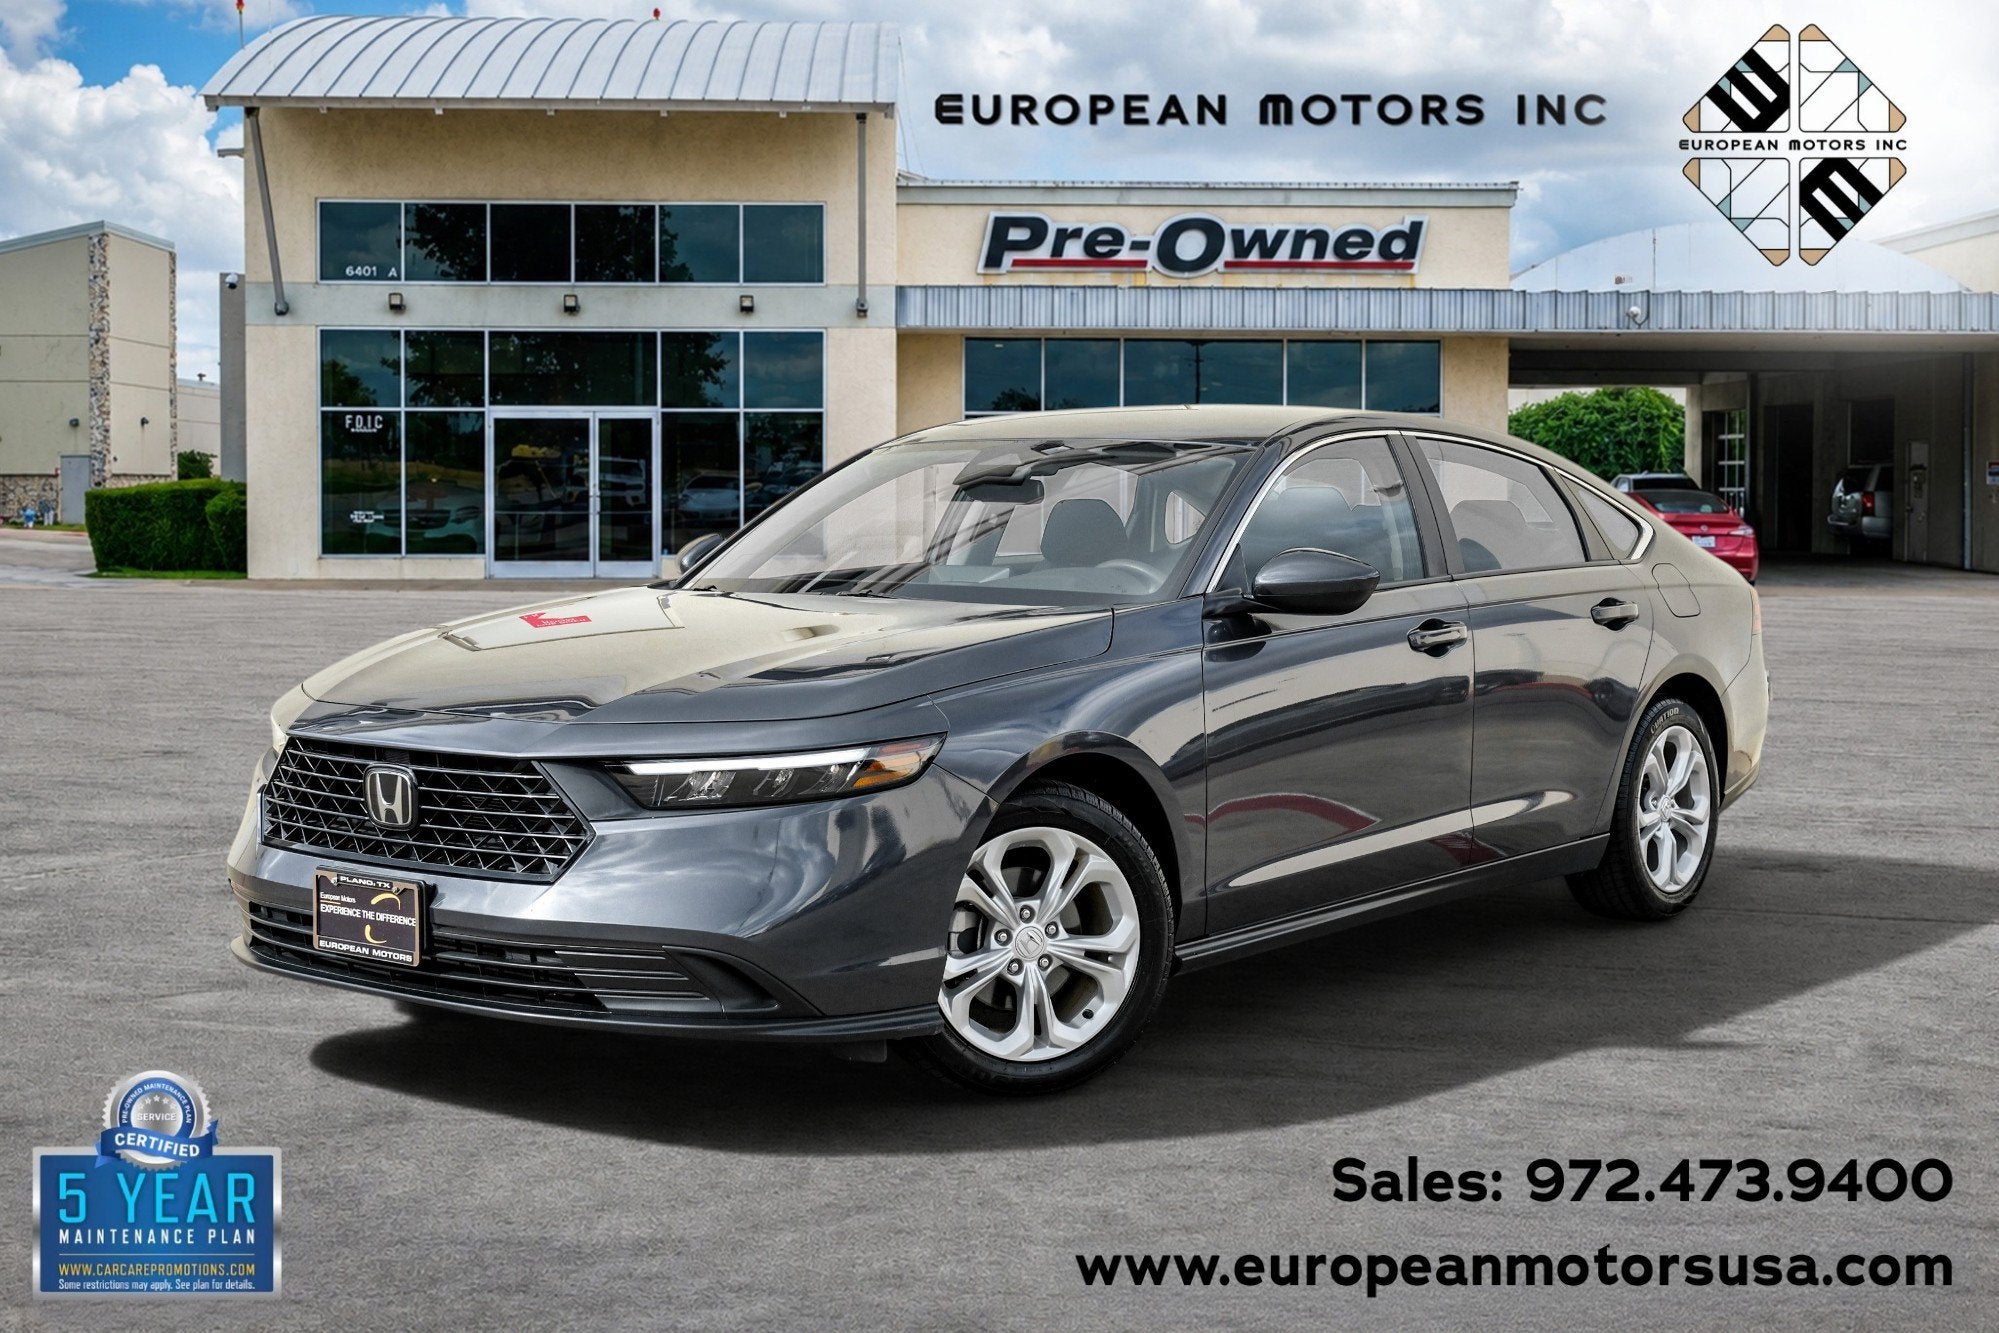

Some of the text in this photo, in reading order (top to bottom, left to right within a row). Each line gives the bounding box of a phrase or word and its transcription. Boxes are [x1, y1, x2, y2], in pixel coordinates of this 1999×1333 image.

[983, 215, 1423, 273] Pre-Owned
[345, 265, 398, 278] 6401 A
[376, 881, 391, 889] TX
[319, 892, 341, 901] European
[320, 904, 417, 927] EXPERIENCE THE DIFFERENCE
[319, 940, 413, 962] EUROPEAN MOTORS
